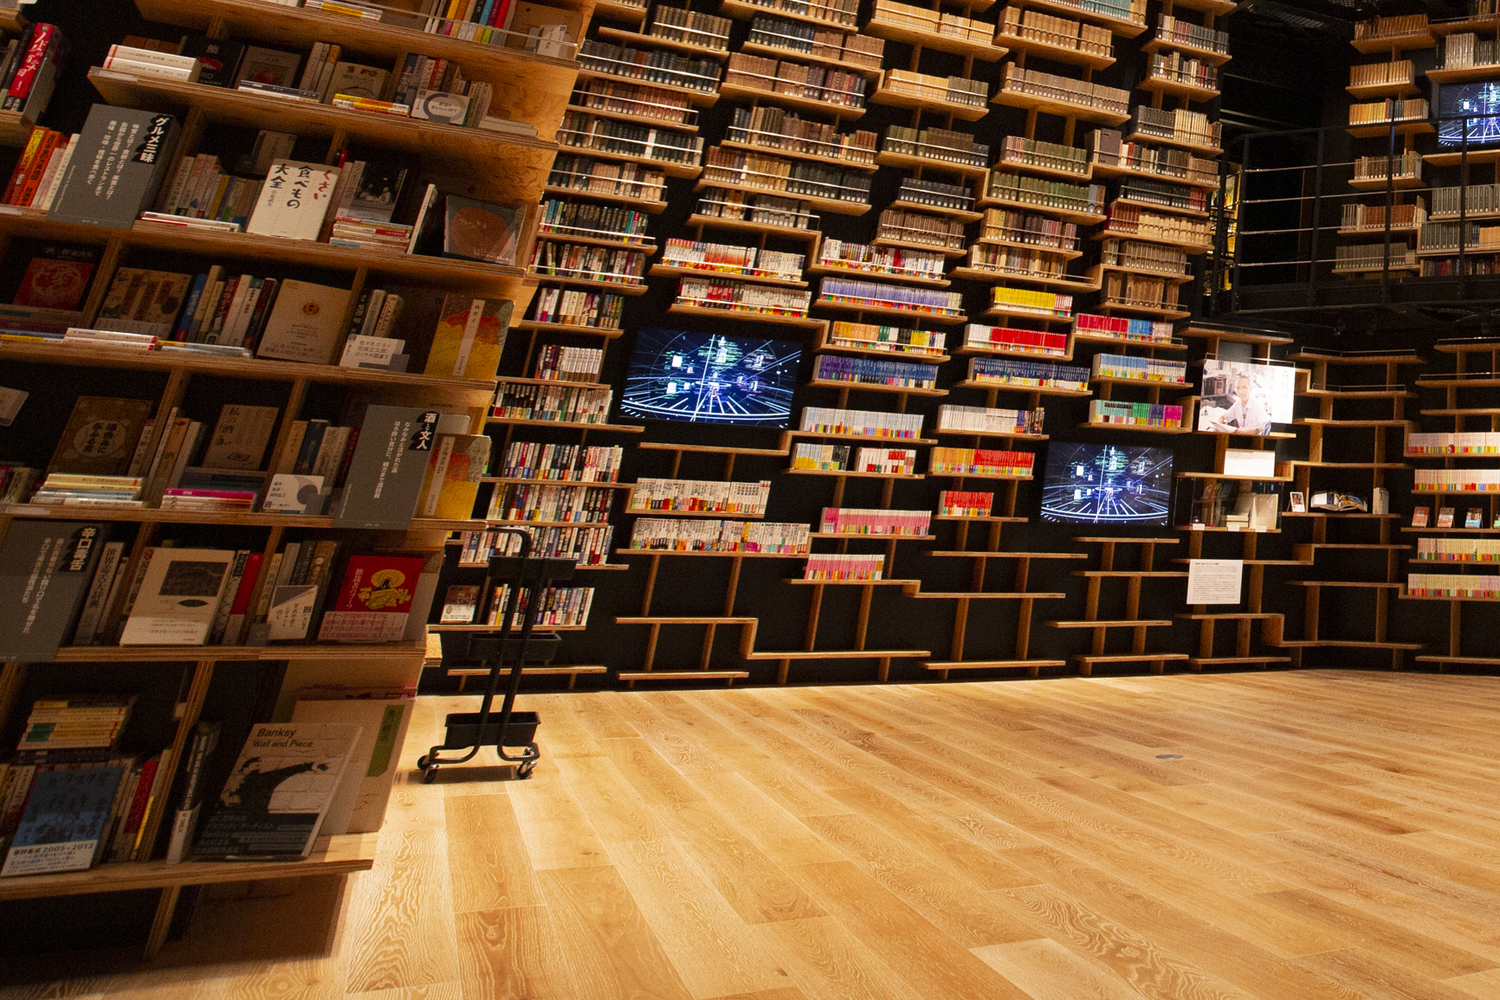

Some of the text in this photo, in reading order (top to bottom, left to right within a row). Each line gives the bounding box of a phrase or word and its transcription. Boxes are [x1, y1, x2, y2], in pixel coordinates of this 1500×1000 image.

[268, 162, 290, 190] 大全
[286, 165, 314, 210] 食べもの
[221, 407, 240, 434] 私の酒
[252, 739, 314, 748] Wall and Piece
[257, 728, 297, 738] Banksy
